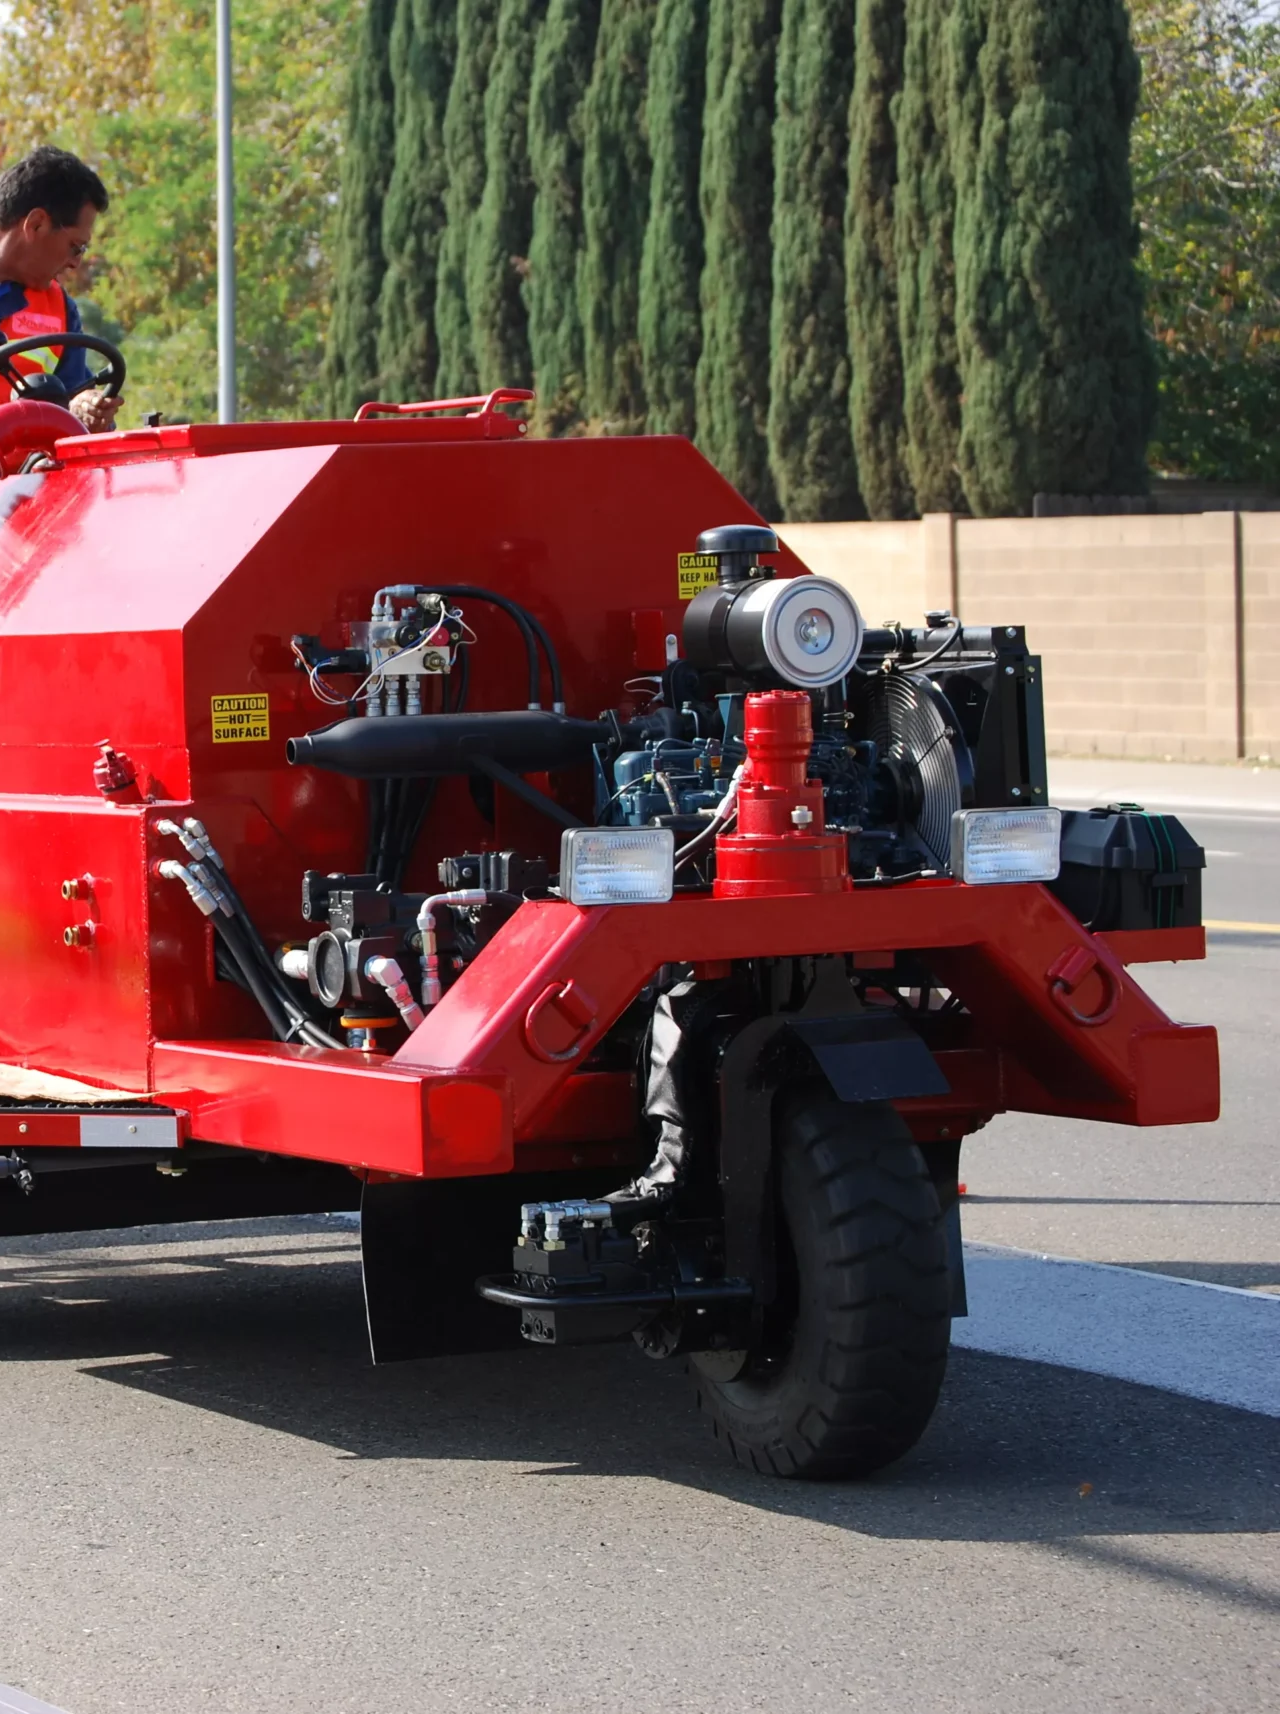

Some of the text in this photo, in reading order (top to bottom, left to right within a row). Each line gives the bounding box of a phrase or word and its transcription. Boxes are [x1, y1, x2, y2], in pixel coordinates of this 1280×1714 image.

[680, 571, 717, 583] KEEP HA
[214, 698, 266, 711] CAUTION
[229, 714, 251, 724] HOT
[214, 727, 267, 739] SURFACE
